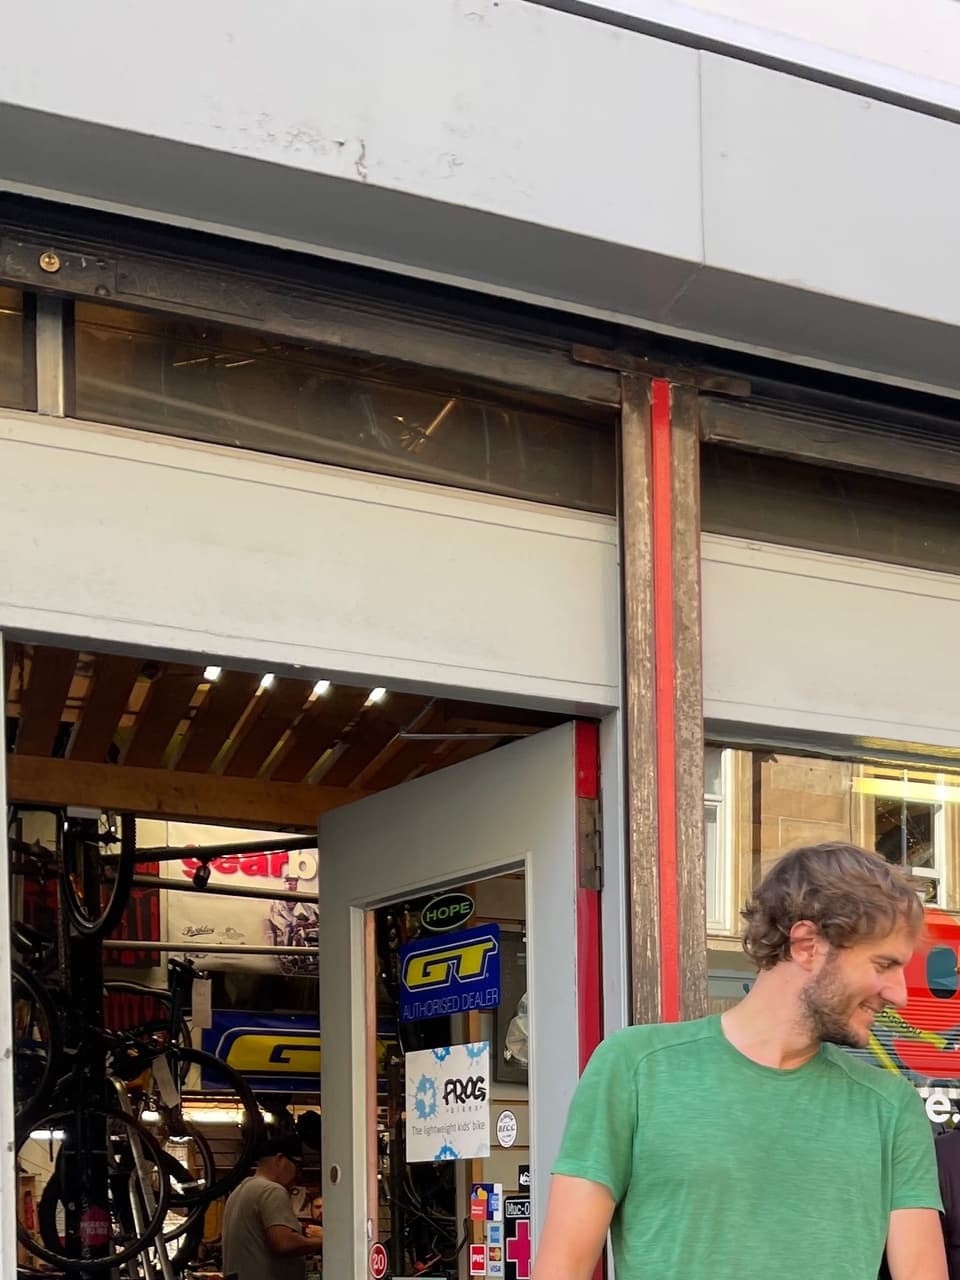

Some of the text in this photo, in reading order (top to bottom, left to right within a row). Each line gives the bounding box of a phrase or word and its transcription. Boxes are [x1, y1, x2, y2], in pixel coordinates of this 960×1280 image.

[426, 901, 471, 923] HOPE
[405, 939, 495, 990] GT
[403, 988, 499, 1020] AUTHORISED DEALER
[226, 1033, 321, 1073] G
[442, 1075, 487, 1105] FROG
[412, 1126, 422, 1136] The
[424, 1123, 457, 1137] lightweight
[473, 1120, 485, 1131] bike
[372, 1254, 384, 1270] 20
